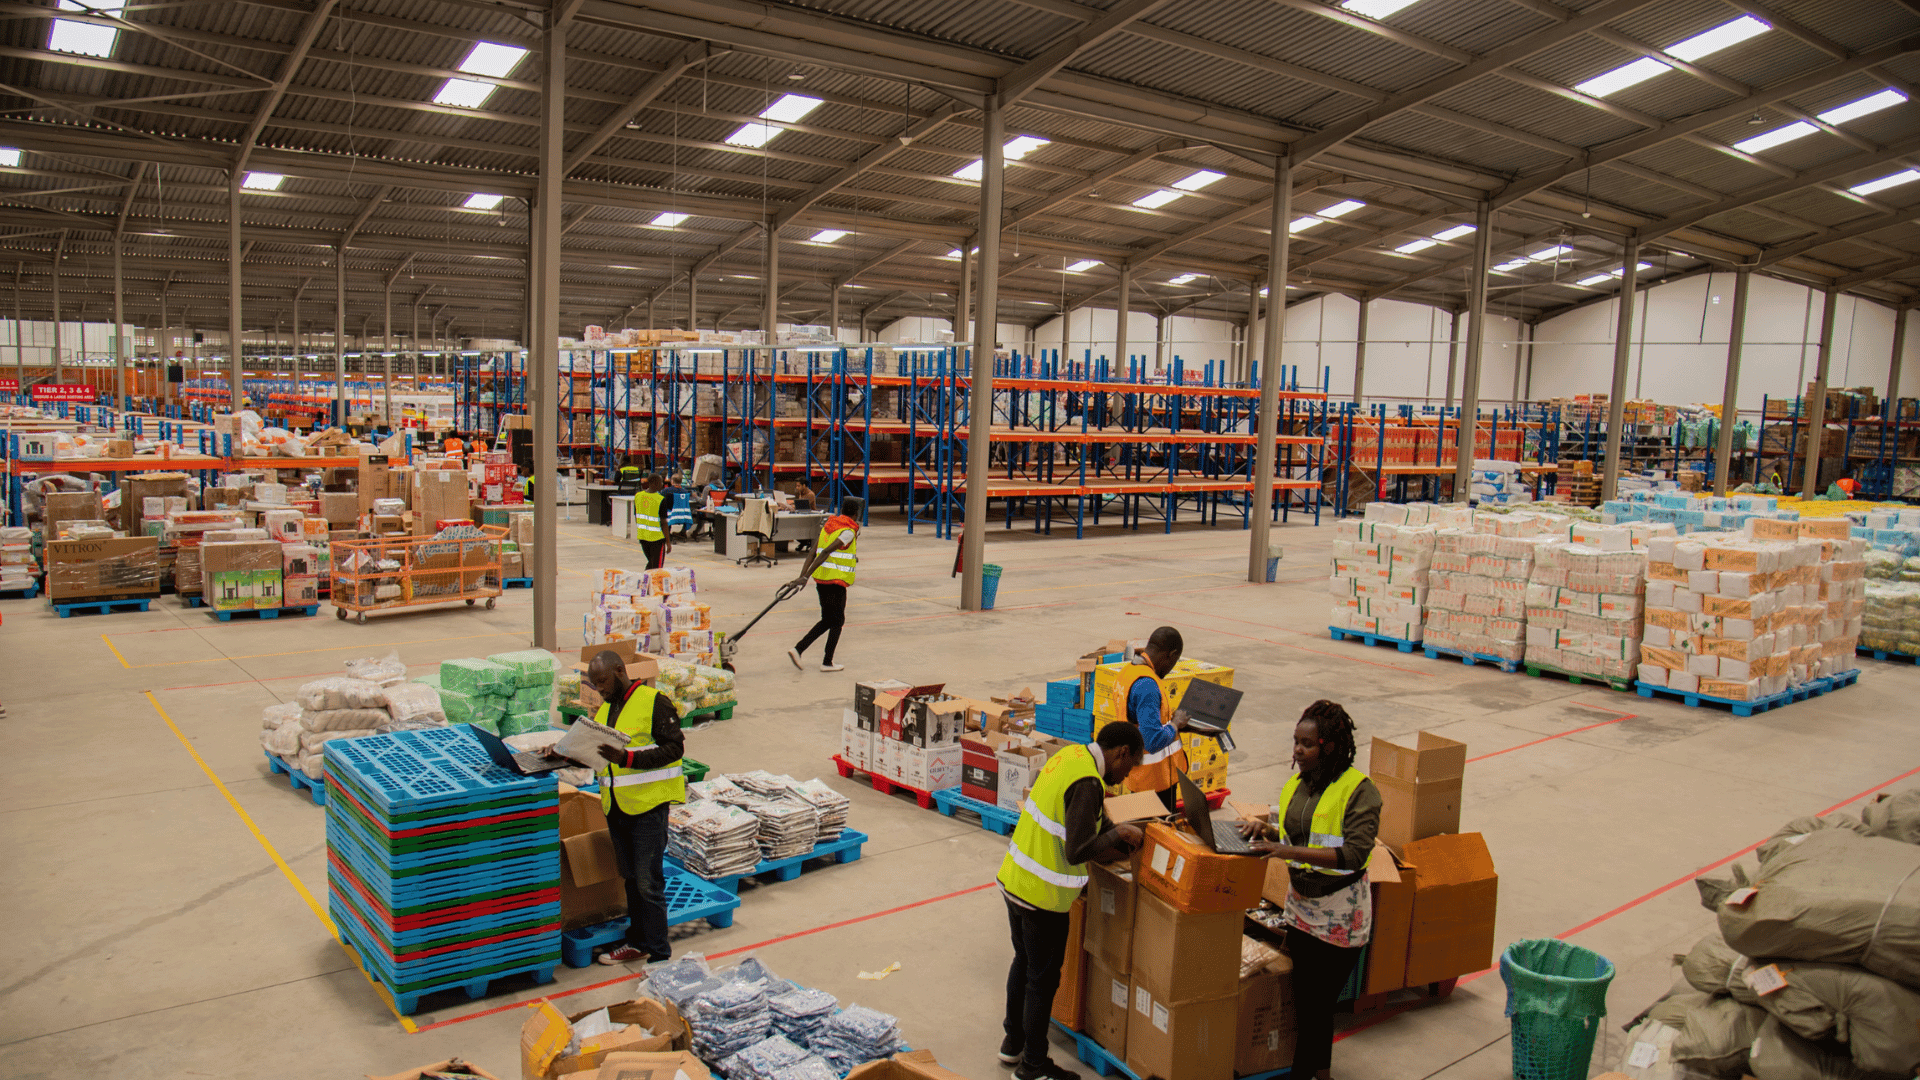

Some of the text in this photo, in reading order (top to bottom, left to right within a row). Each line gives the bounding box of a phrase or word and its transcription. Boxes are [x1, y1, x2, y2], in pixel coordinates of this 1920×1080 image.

[38, 386, 58, 394] TIER
[69, 386, 74, 394] 3
[76, 386, 83, 394] &
[84, 386, 90, 394] 4
[53, 543, 102, 554] VITRON
